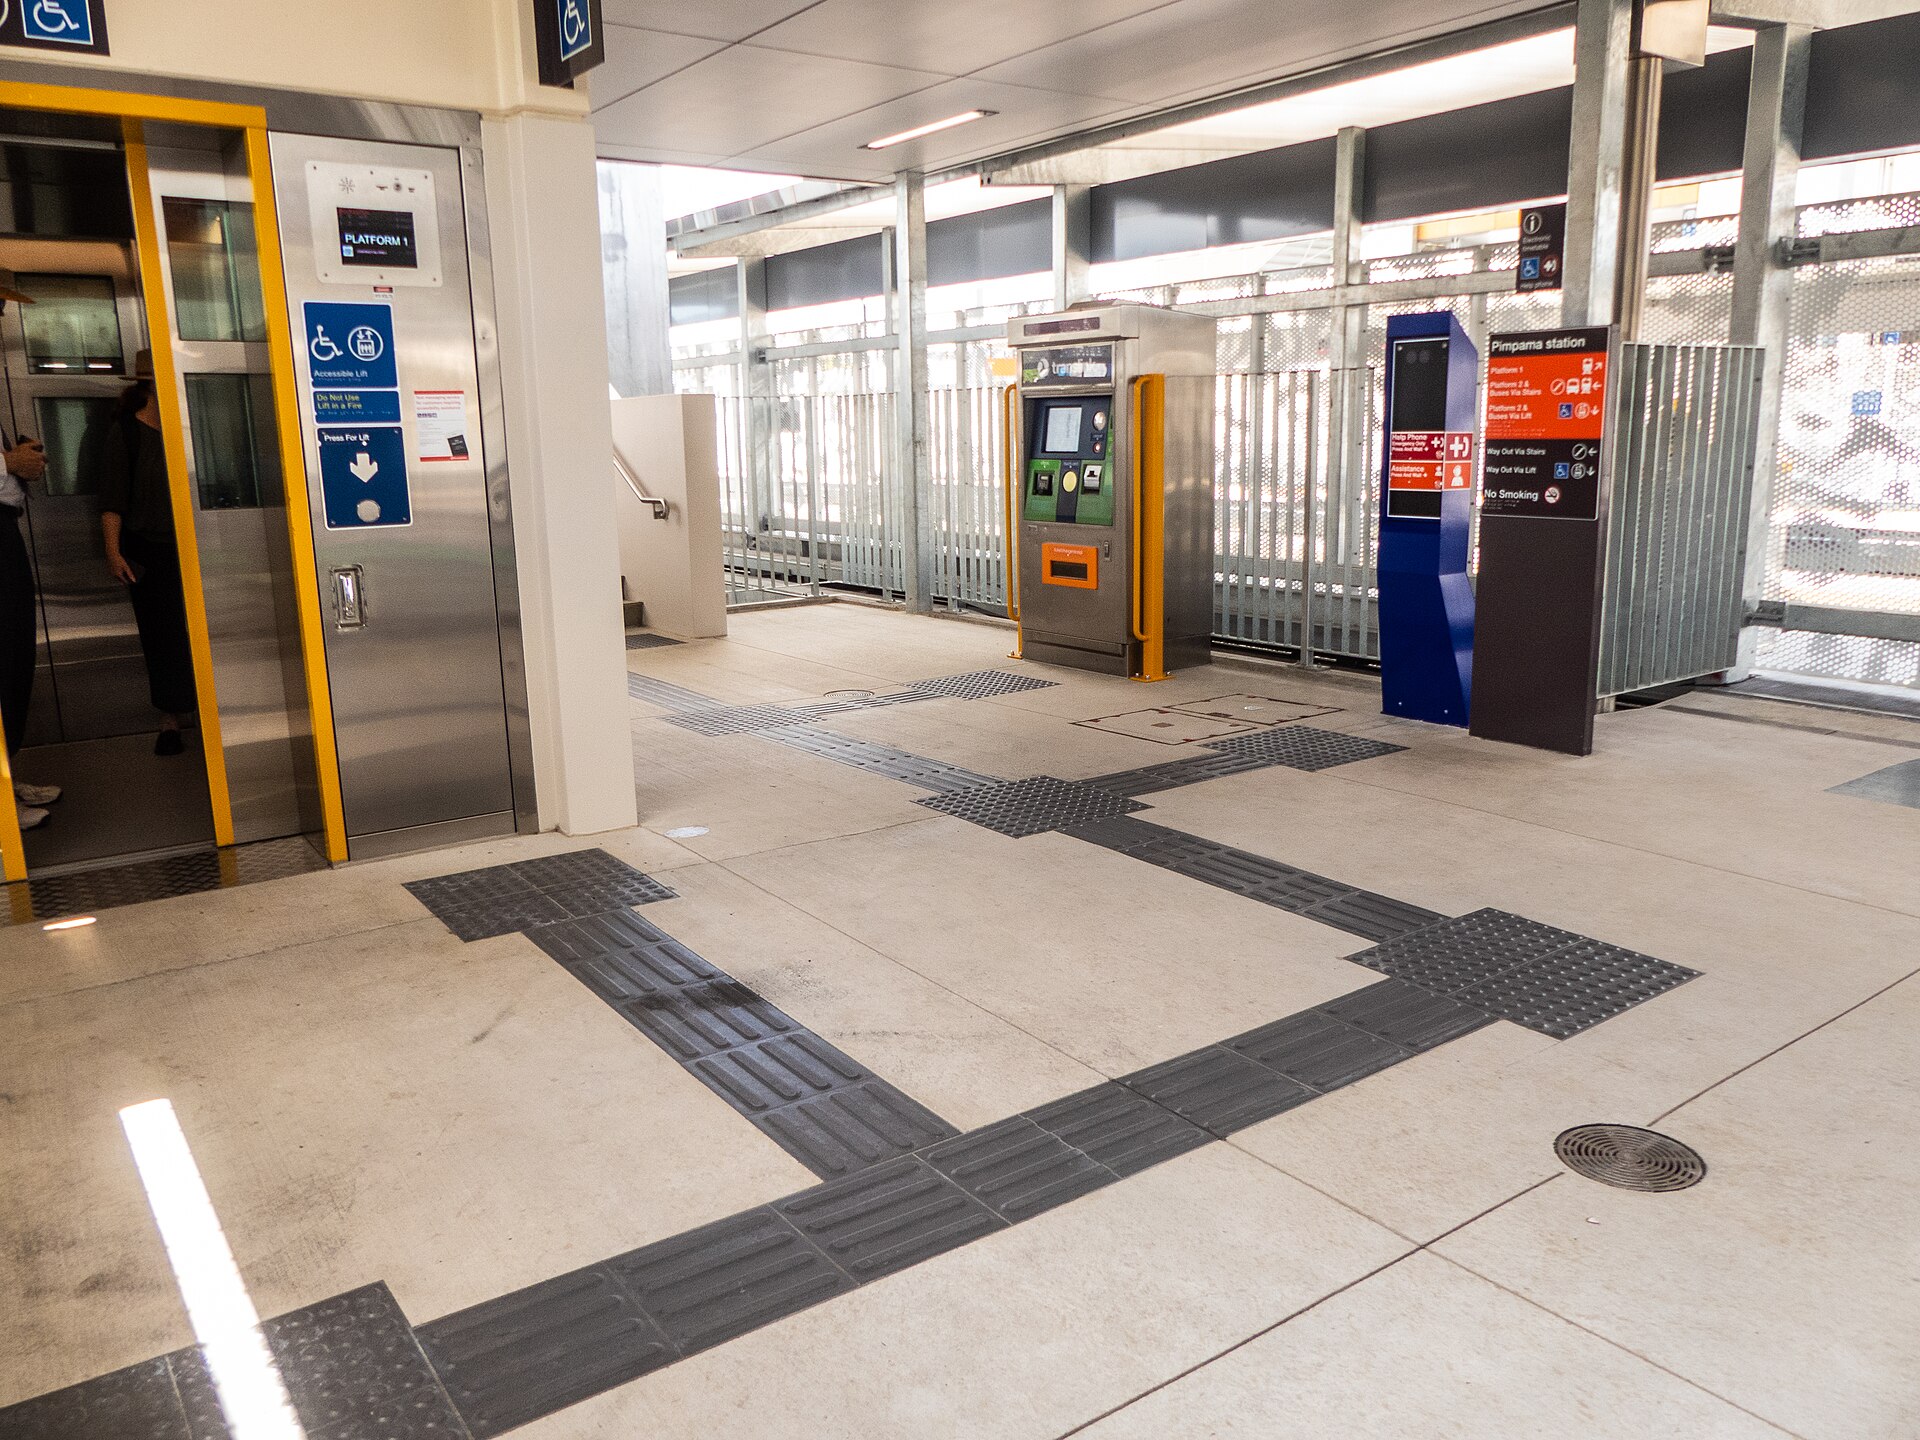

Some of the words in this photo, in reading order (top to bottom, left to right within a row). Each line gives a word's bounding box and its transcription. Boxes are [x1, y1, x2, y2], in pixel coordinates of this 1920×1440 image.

[345, 234, 401, 246] PLATFORM
[403, 236, 409, 247] 1
[1491, 340, 1543, 353] Pimpama
[1545, 337, 1586, 349] station
[314, 370, 354, 378] Accessible
[356, 370, 369, 378] Lift
[1490, 366, 1519, 374] Platform
[1490, 381, 1517, 389] Platform
[1517, 380, 1523, 388] 2
[1524, 380, 1530, 388] &
[1489, 389, 1510, 397] Buses
[1522, 388, 1542, 396] Stairs
[317, 394, 328, 402] Do
[330, 394, 343, 402] Not
[345, 394, 360, 402] Use
[317, 402, 330, 410] Lift
[347, 402, 362, 410] Fire
[1489, 404, 1516, 412] Platform
[1516, 404, 1522, 412] 2
[1488, 412, 1508, 420] Buses
[1509, 412, 1520, 420] Via
[1520, 412, 1532, 420] Lift
[324, 434, 345, 442] Press
[359, 434, 370, 442] Lift
[1486, 448, 1500, 457] Way
[1526, 447, 1546, 455] Stairs
[1486, 466, 1499, 475] Way
[1500, 466, 1513, 474] Out
[1513, 466, 1524, 474] Via
[1525, 466, 1536, 474] Lift
[1484, 489, 1497, 498] No
[1499, 489, 1539, 502] Smoking
